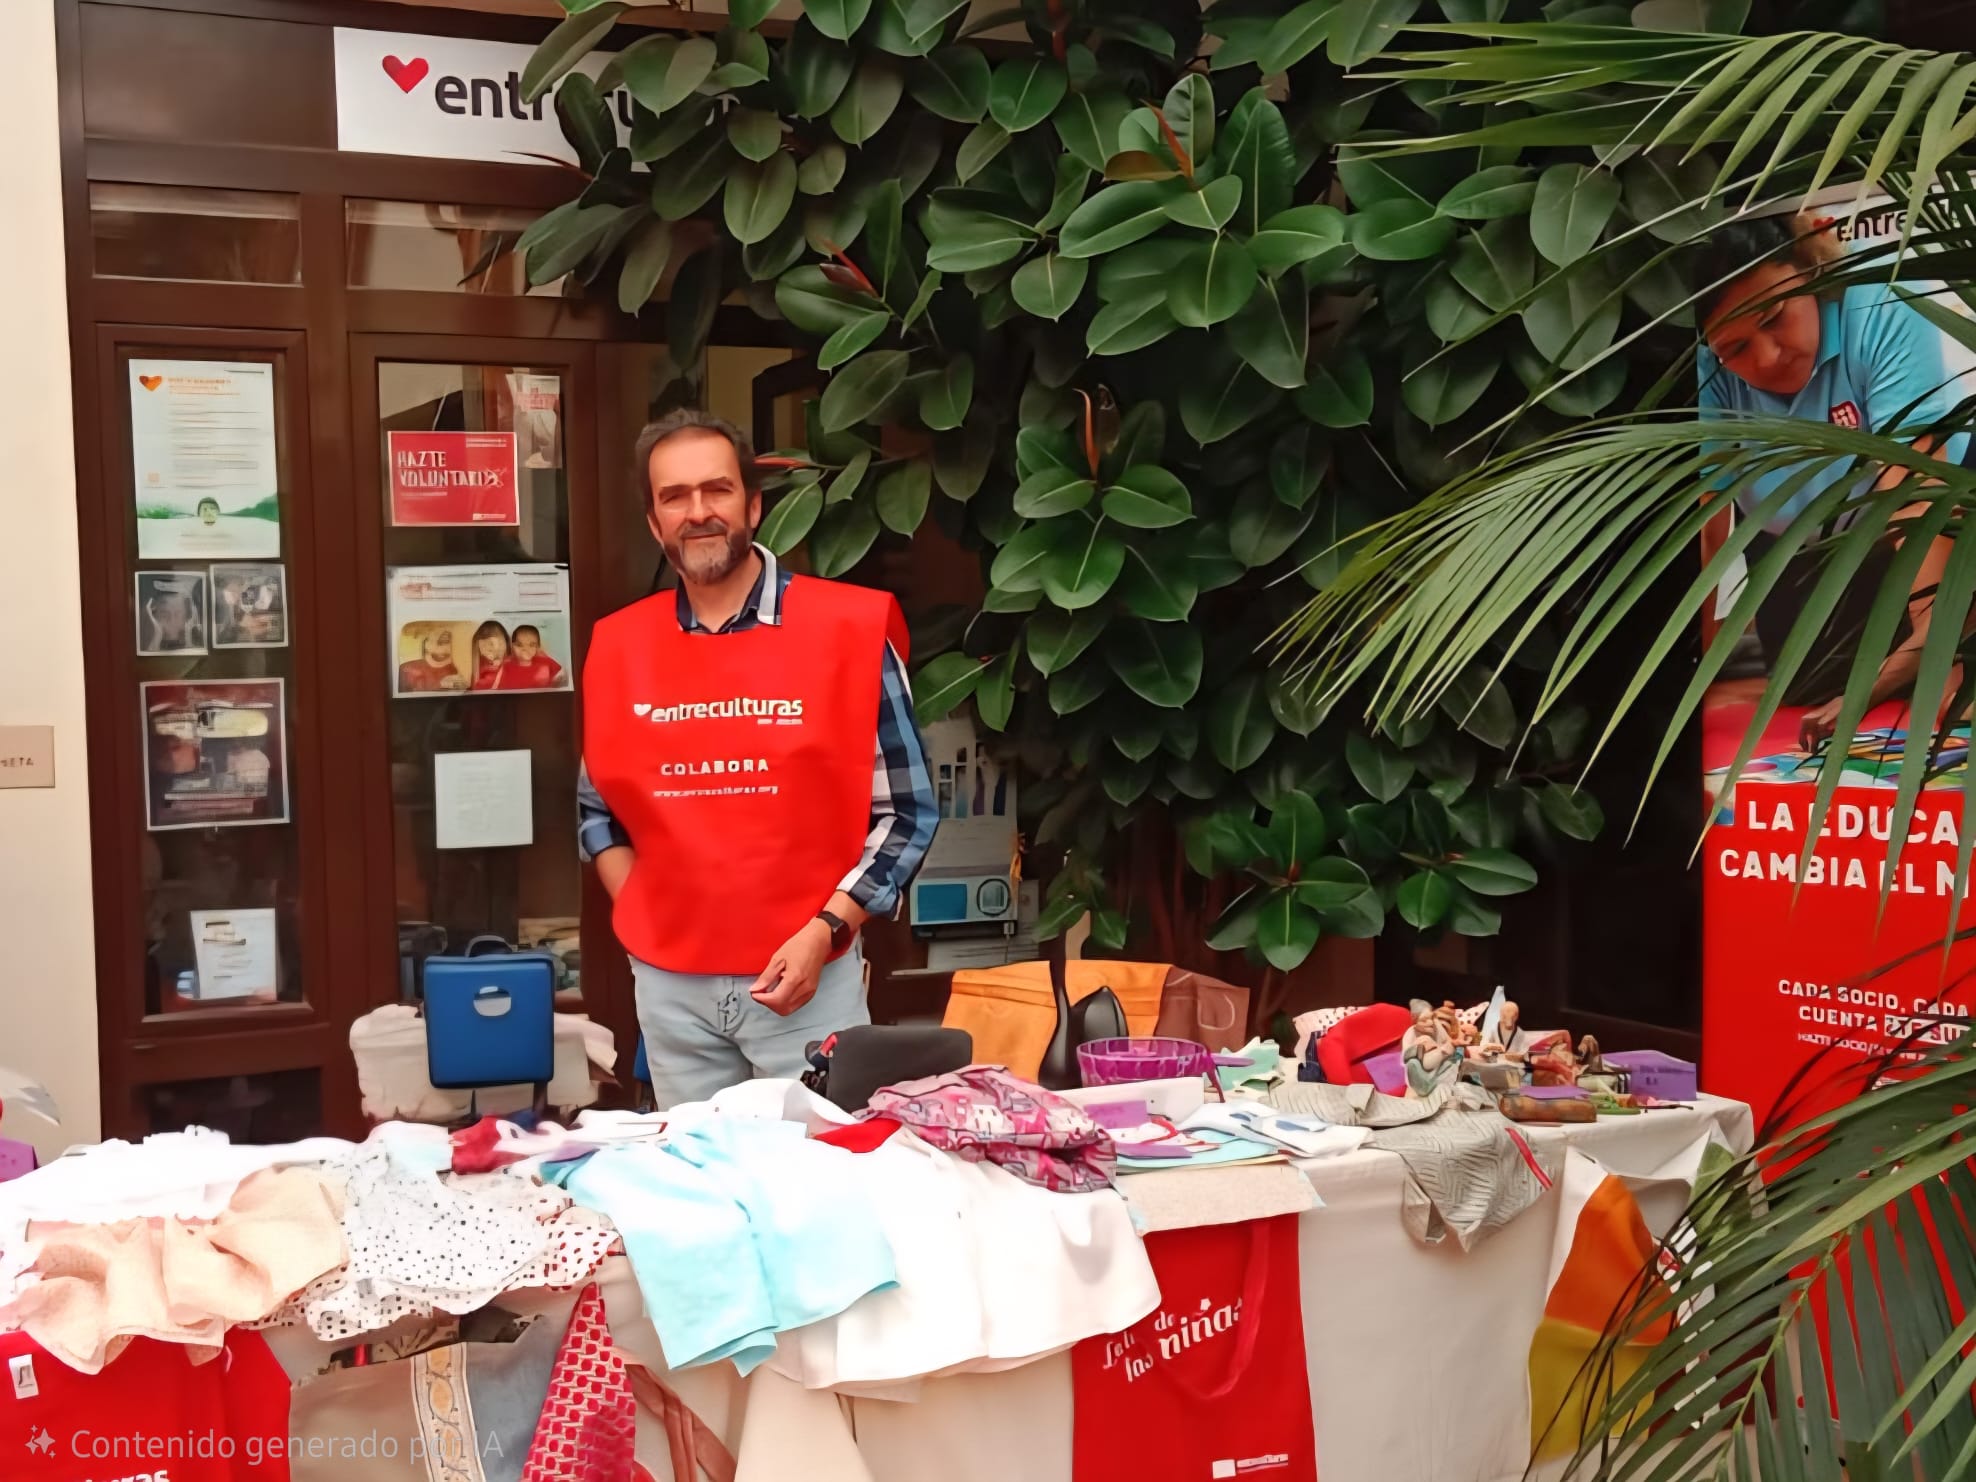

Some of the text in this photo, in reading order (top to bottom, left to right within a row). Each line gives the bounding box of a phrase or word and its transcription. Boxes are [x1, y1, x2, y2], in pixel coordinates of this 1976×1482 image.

[398, 450, 446, 467] HAZTE
[651, 697, 803, 722] entreculturas
[661, 759, 768, 776] COLABORA
[1749, 800, 1794, 832] LA
[1720, 849, 1867, 889] CAMBIA
[1879, 860, 1925, 894] EL
[1778, 979, 1831, 1000] CADA
[1799, 1006, 1878, 1031] CUENTA
